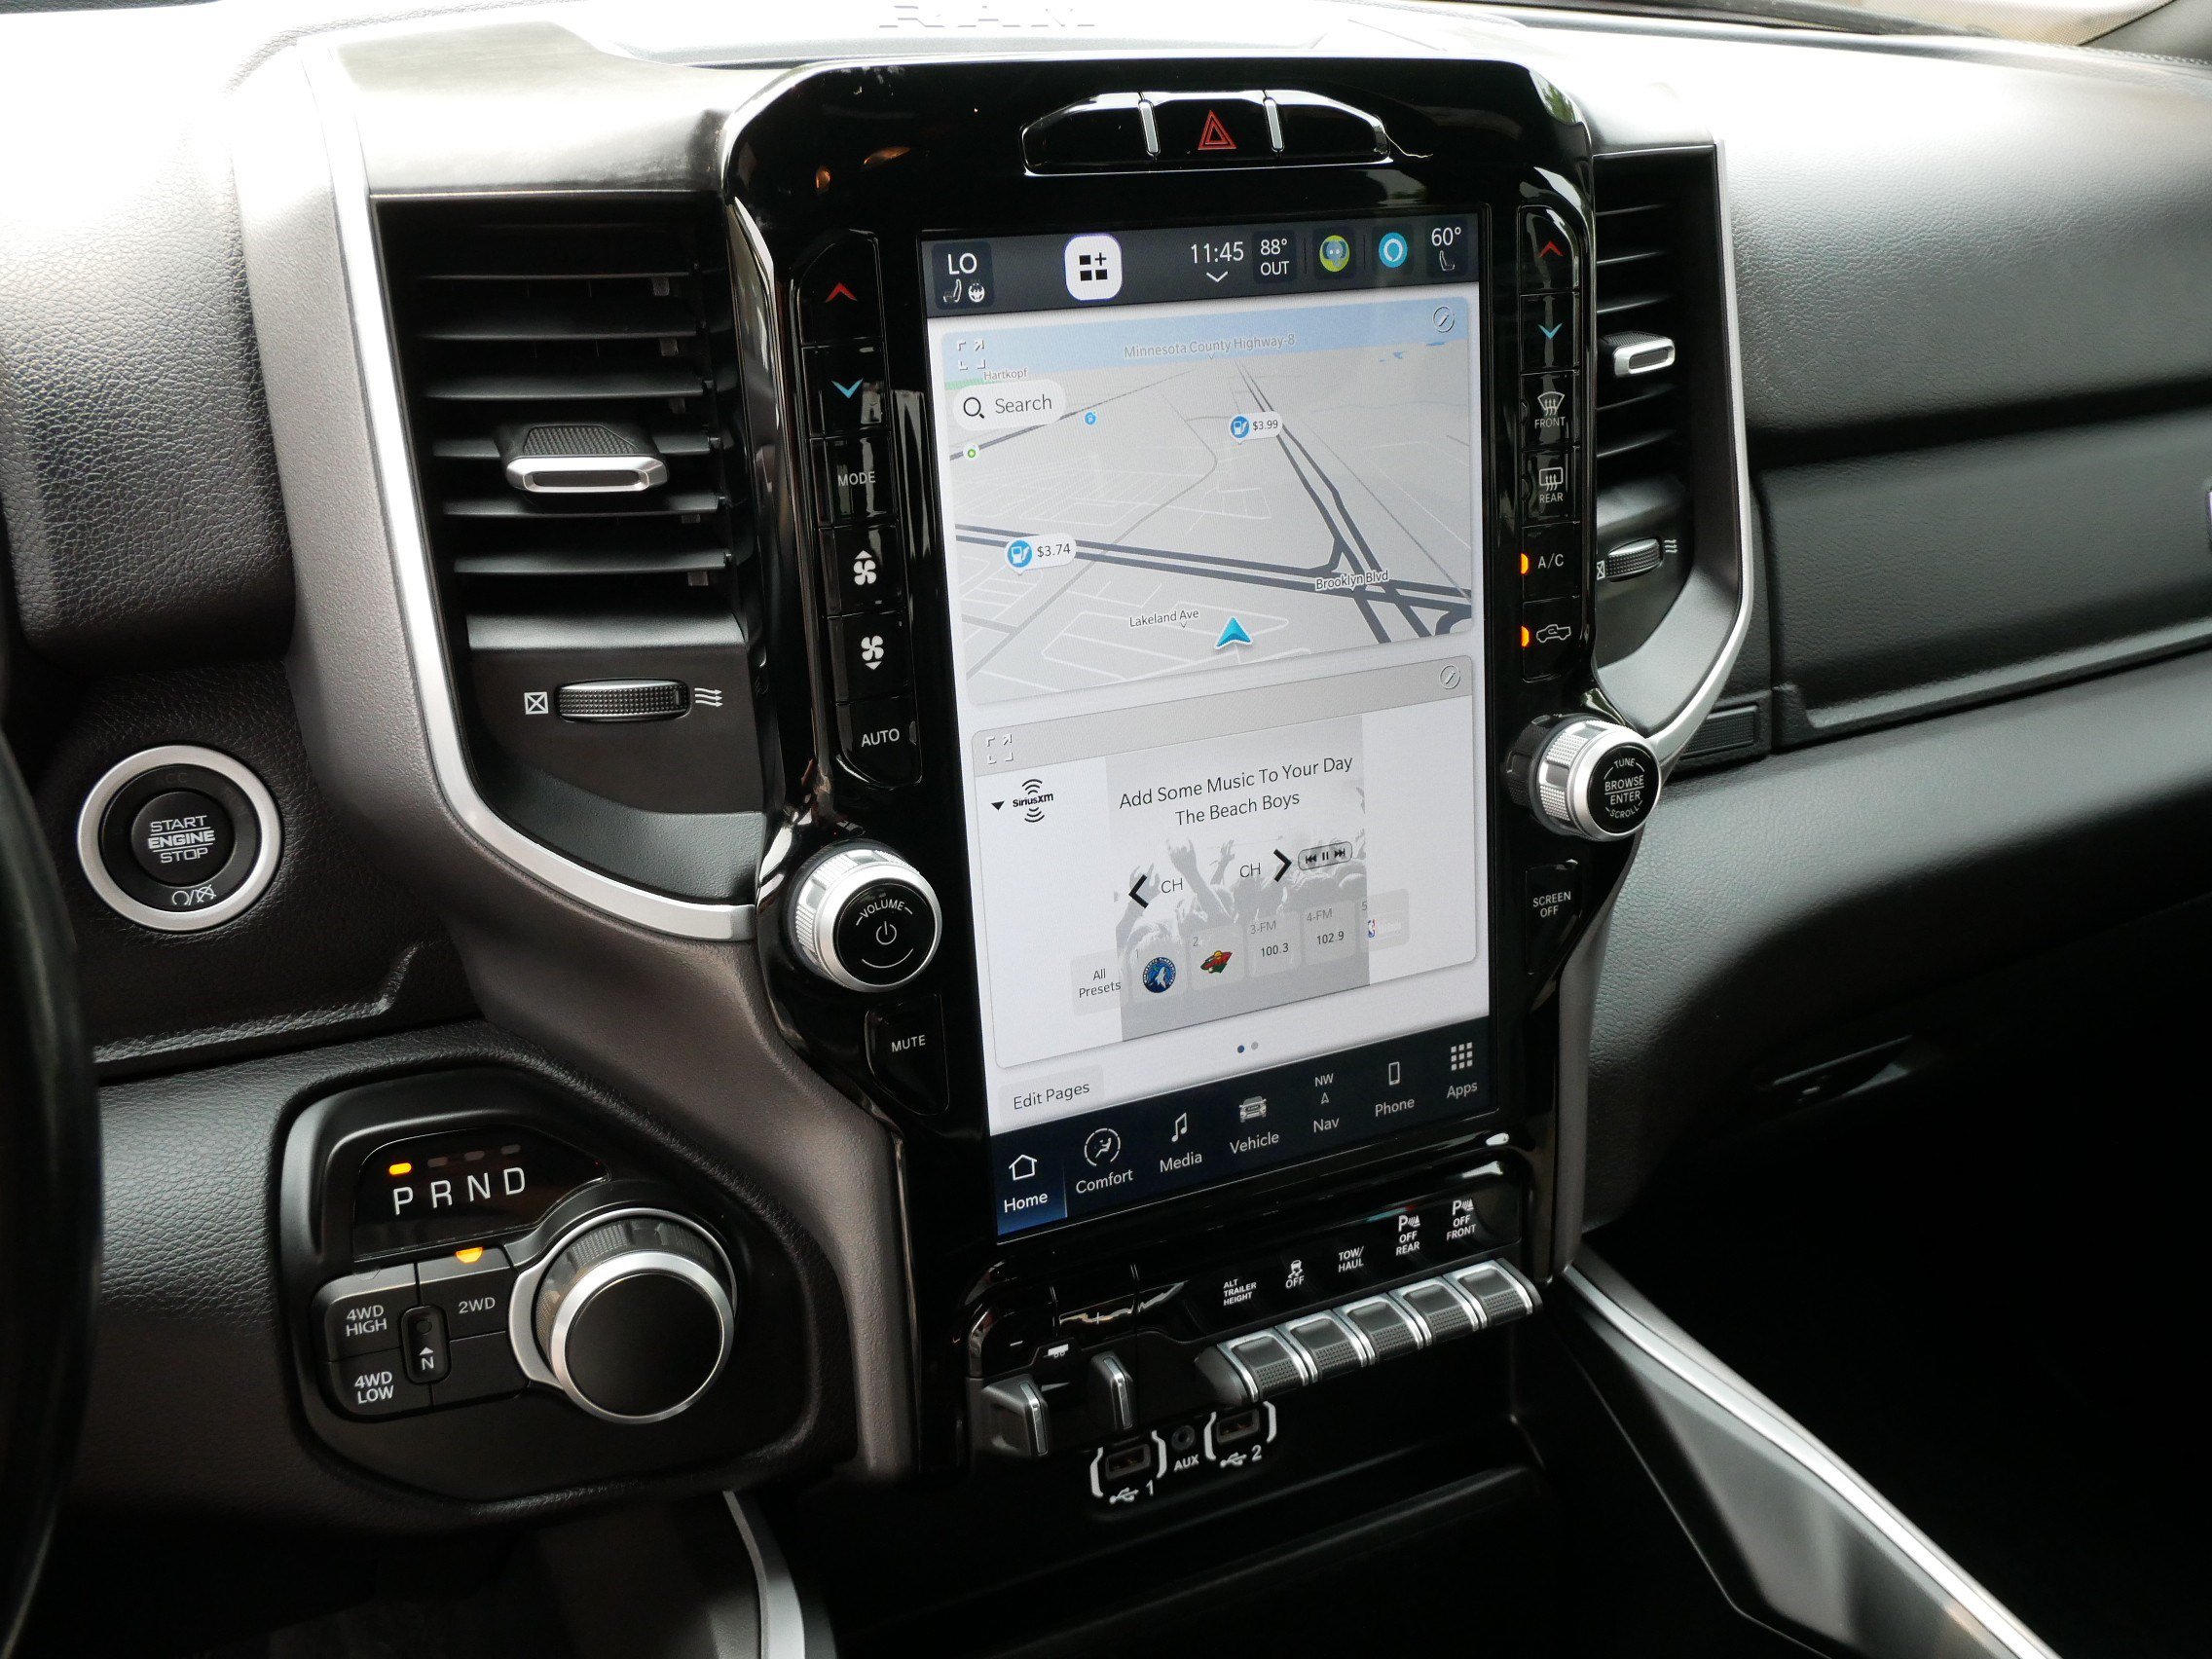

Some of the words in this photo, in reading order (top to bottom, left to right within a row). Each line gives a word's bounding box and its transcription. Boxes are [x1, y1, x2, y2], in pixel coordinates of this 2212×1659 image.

[1431, 228, 1461, 247] 60°
[1190, 242, 1244, 264] 11:45
[1261, 239, 1288, 256] 88°
[947, 253, 977, 276] LO
[1261, 261, 1289, 276] OUT
[1124, 342, 1187, 358] Minnesota
[1190, 340, 1231, 356] County
[983, 367, 1027, 382] Hartkopf
[995, 395, 1052, 414] Search
[1252, 419, 1278, 432] $3.99
[1534, 417, 1566, 428] FRONT
[837, 470, 876, 486] MODE
[1539, 492, 1564, 503] REAR
[1037, 543, 1070, 557] $3.74
[1537, 554, 1564, 569] A/C
[1315, 573, 1363, 588] Brooklyn
[1365, 570, 1389, 583] Blvd
[1129, 609, 1177, 627] Lakeland
[1179, 609, 1199, 620] Ave
[861, 727, 901, 748] AUTO
[1614, 758, 1635, 768] TUNE
[1120, 791, 1153, 809] Add
[1156, 784, 1203, 800] Some
[1207, 775, 1254, 793] Music
[1259, 768, 1278, 783] To
[1282, 762, 1317, 780] Your
[1323, 756, 1352, 776] Day
[1604, 775, 1644, 791] BROWSE
[1610, 791, 1641, 805] ENTER
[1175, 808, 1205, 826] The
[1209, 798, 1258, 821] Beach
[1263, 792, 1300, 814] Boys
[1609, 804, 1640, 818] SCROLL
[151, 815, 206, 831] START
[148, 830, 215, 849] ENGINE
[161, 847, 208, 864] STOP
[1239, 863, 1261, 878] CH
[1161, 878, 1183, 894] CH
[1532, 891, 1571, 907] SCREEN
[860, 899, 904, 918] VOLUME
[1307, 907, 1332, 922] 4-FM
[1540, 905, 1558, 918] OFF
[1250, 919, 1276, 935] 3-FM
[1193, 937, 1199, 947] 2
[1316, 931, 1345, 946] 102.9
[1261, 942, 1289, 957] 100.3
[1093, 969, 1106, 981] All
[1078, 979, 1121, 997] Presets
[891, 1035, 925, 1052] MUTE
[1314, 1073, 1334, 1086] NW
[1014, 1090, 1042, 1110] Edit
[1046, 1082, 1089, 1106] Pages
[1447, 1081, 1478, 1098] Apps
[1375, 1097, 1415, 1117] Phone
[1313, 1117, 1340, 1132] Nav
[1230, 1131, 1279, 1154] Vehicle
[1160, 1152, 1202, 1172] Media
[1076, 1168, 1133, 1194] Comfort
[393, 1187, 413, 1215] P
[430, 1180, 452, 1208] R
[467, 1173, 491, 1202] N
[503, 1167, 525, 1196] D
[1004, 1192, 1049, 1213] Home
[1454, 1214, 1470, 1227] OFF
[1399, 1231, 1417, 1244] OFF
[1447, 1224, 1476, 1239] FRONT
[1338, 1246, 1364, 1261] TOW/
[1396, 1241, 1419, 1254] REAR
[1338, 1259, 1364, 1273] HAUL
[1223, 1279, 1238, 1290] ALT
[1285, 1274, 1304, 1288] OFF
[1223, 1282, 1257, 1297] TRAILER
[459, 1297, 496, 1315] 2WD
[1223, 1292, 1253, 1307] HEIGHT
[346, 1305, 385, 1321] 4WD
[346, 1317, 387, 1337] HIGH
[421, 1355, 434, 1371] N
[353, 1370, 393, 1388] 4WD
[356, 1384, 394, 1404] LOW
[1252, 1444, 1263, 1461] 2
[1174, 1455, 1199, 1471] AUX
[1146, 1480, 1155, 1496] 1
